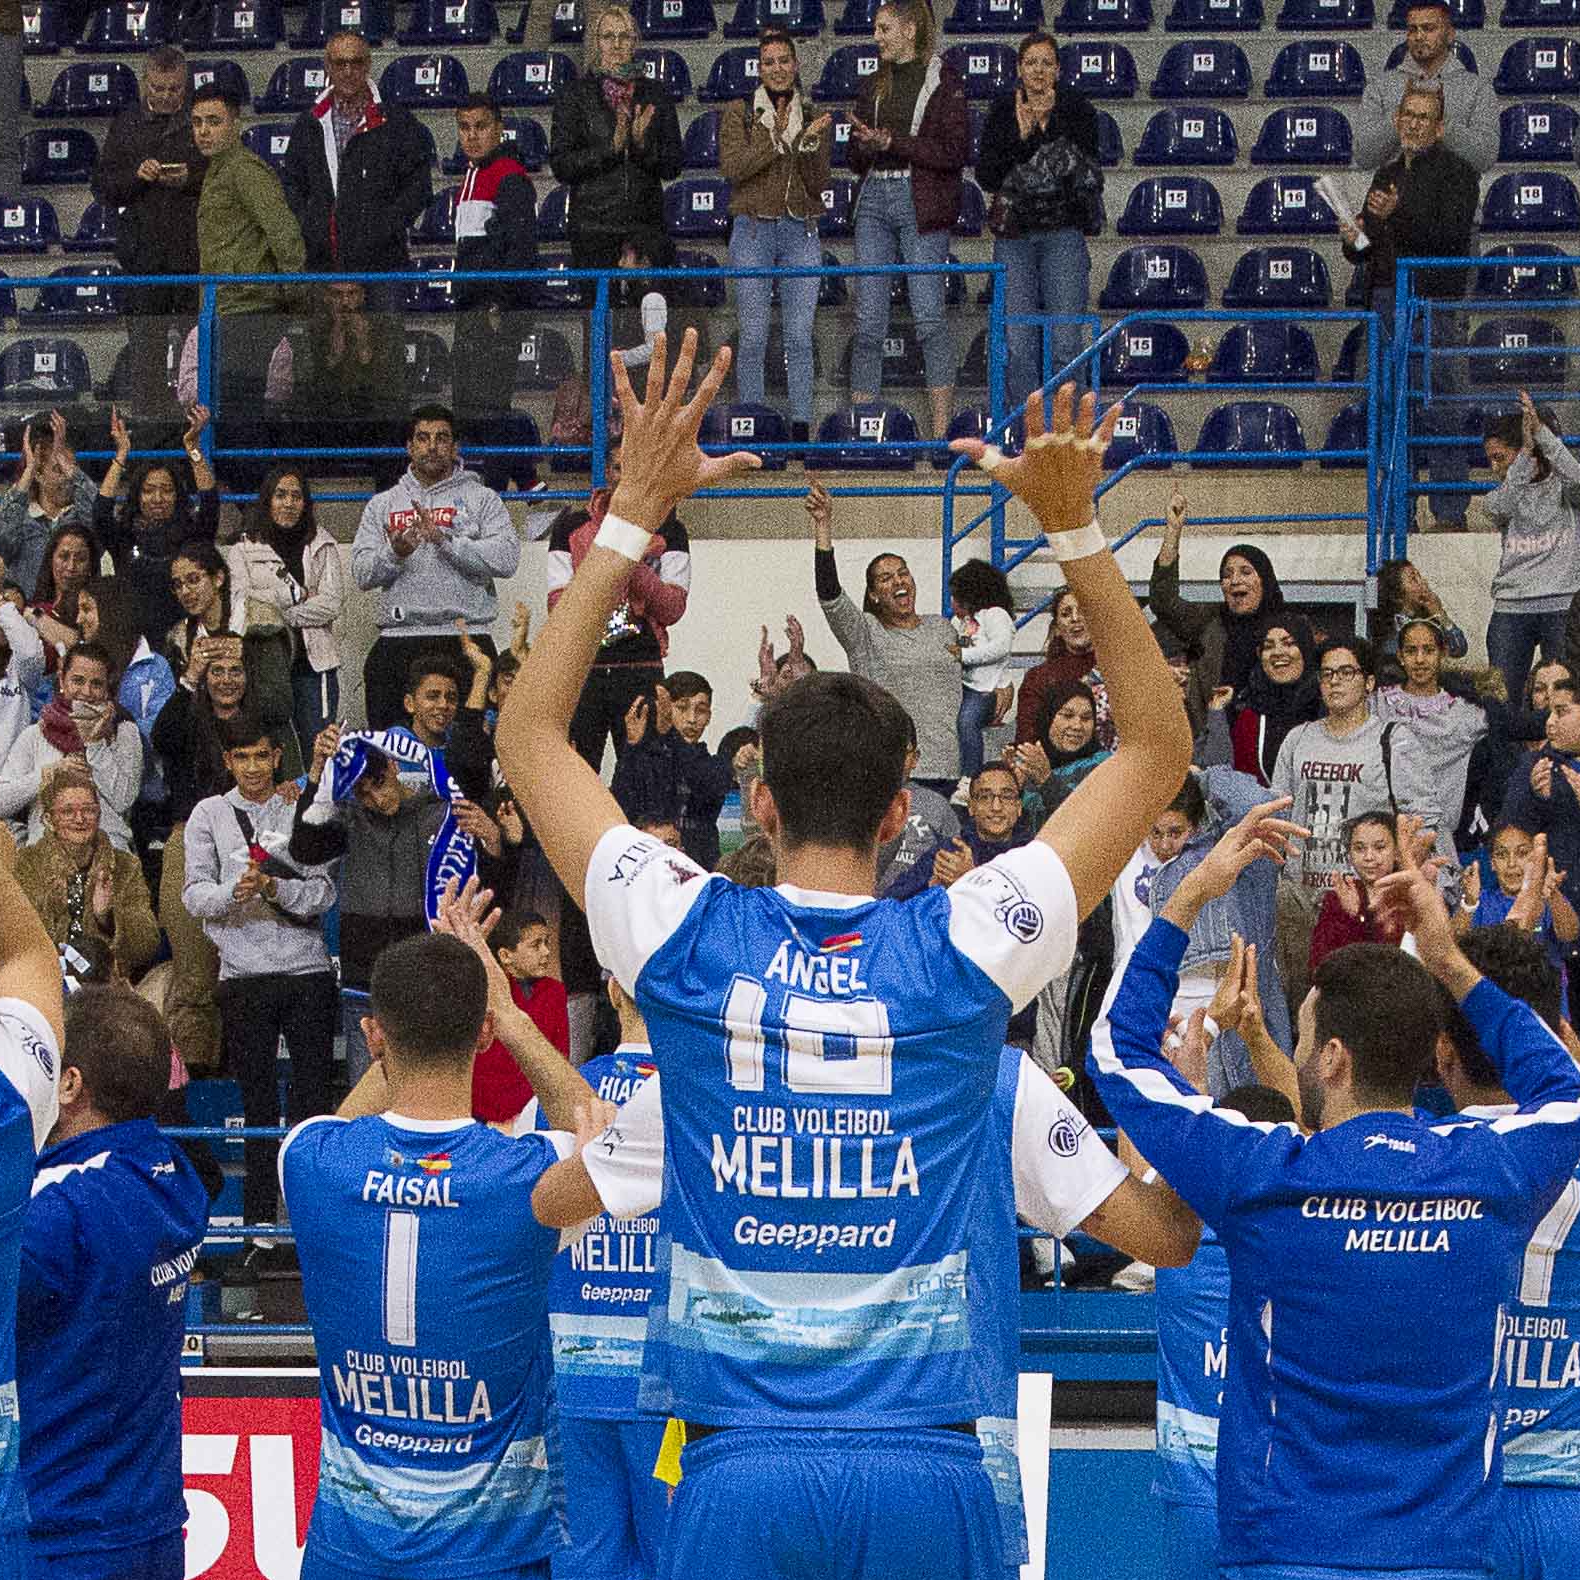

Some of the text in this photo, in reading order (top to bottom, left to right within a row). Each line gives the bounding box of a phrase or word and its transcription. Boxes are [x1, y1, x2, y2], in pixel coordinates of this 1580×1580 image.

[974, 58, 986, 67] 13
[1085, 58, 1098, 67] 14
[1196, 57, 1211, 66] 15
[1312, 57, 1326, 66] 16
[1539, 54, 1553, 63] 18
[862, 61, 875, 70] 12
[1300, 122, 1313, 131] 16
[1532, 118, 1545, 127] 18
[1188, 123, 1200, 132] 15
[1170, 193, 1183, 202] 15
[1288, 193, 1302, 202] 16
[1525, 189, 1539, 198] 18
[697, 196, 710, 205] 11
[1135, 341, 1149, 350] 15
[737, 421, 750, 430] 12
[864, 420, 878, 430] 13
[1118, 422, 1133, 431] 15
[1300, 760, 1364, 783] REEBOK
[764, 940, 869, 996] ÁNGEL
[733, 1105, 895, 1137] CLUB VOLEIBOL
[711, 1132, 921, 1200] MELILLA
[362, 1170, 460, 1209] FAISAL
[1301, 1196, 1367, 1222] CLUB
[733, 1215, 897, 1254] Geeppard
[1344, 1229, 1451, 1253] MELILLA
[382, 1206, 420, 1348] 1
[346, 1349, 471, 1380] CLUB VOLEIBOL
[332, 1363, 493, 1424] MELILLA
[354, 1423, 473, 1456] Geeppard
